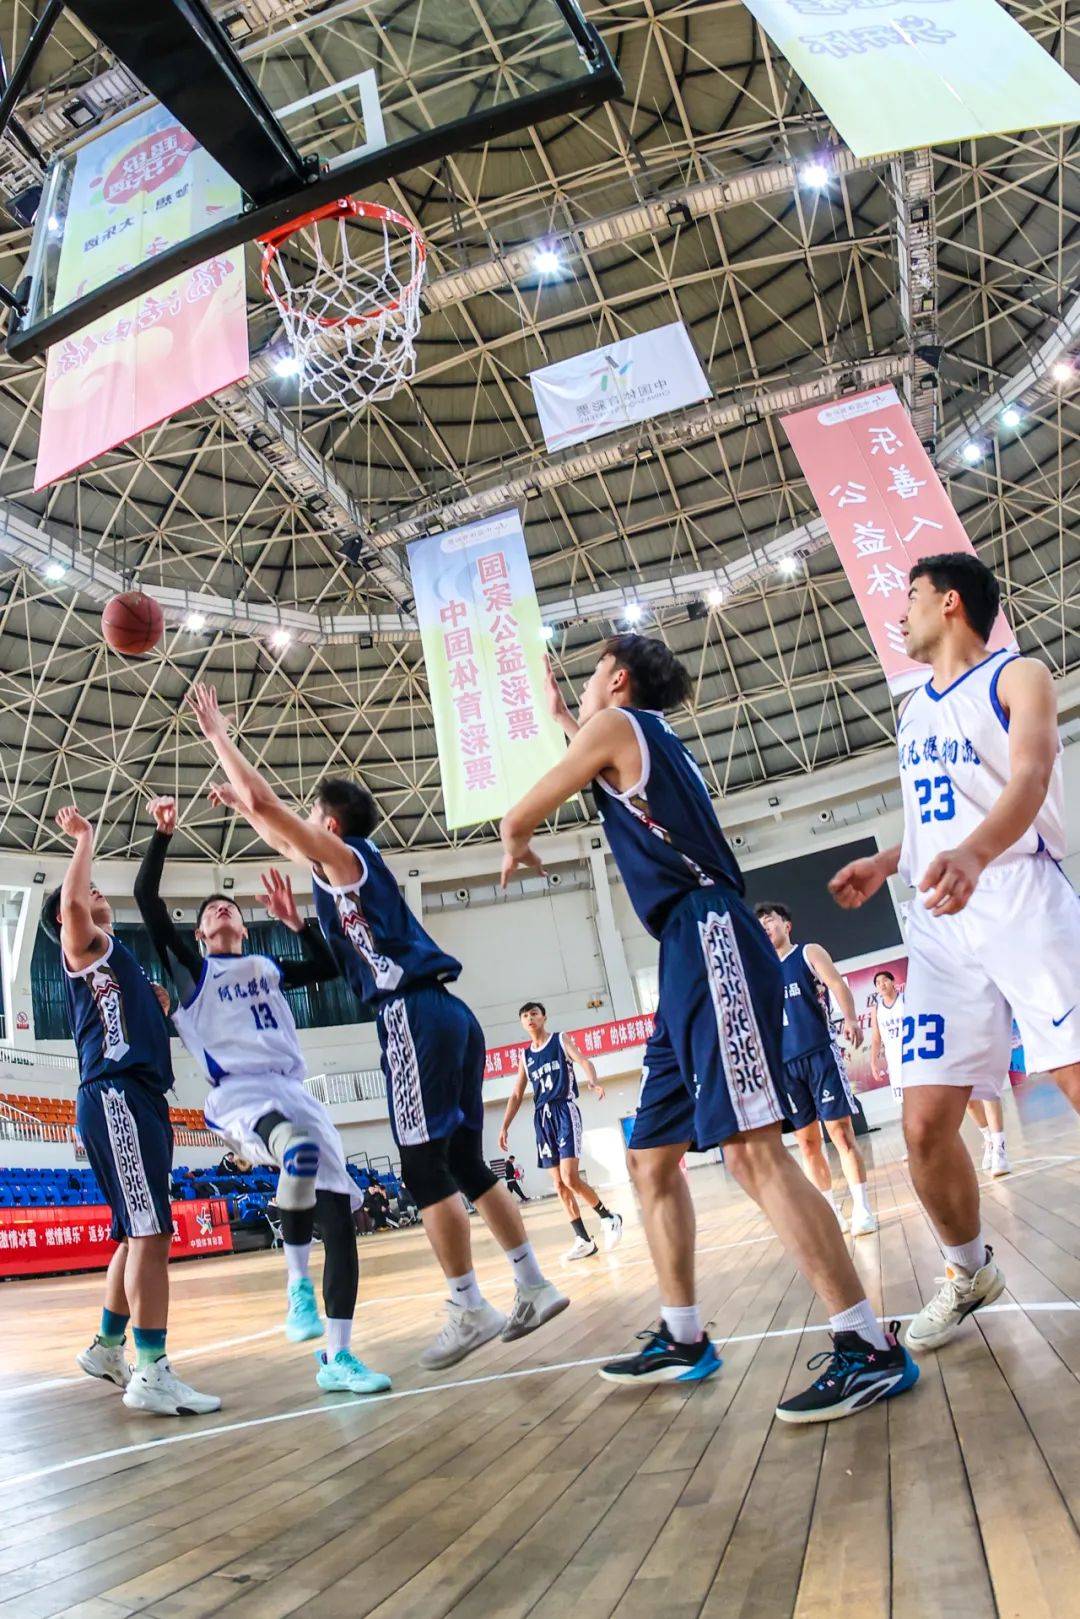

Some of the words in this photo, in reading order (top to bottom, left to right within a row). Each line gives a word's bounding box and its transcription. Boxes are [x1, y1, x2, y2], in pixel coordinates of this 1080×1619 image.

[914, 775, 956, 824] 23
[250, 1002, 278, 1030] 13
[902, 1013, 945, 1062] 23
[540, 1074, 554, 1093] 14
